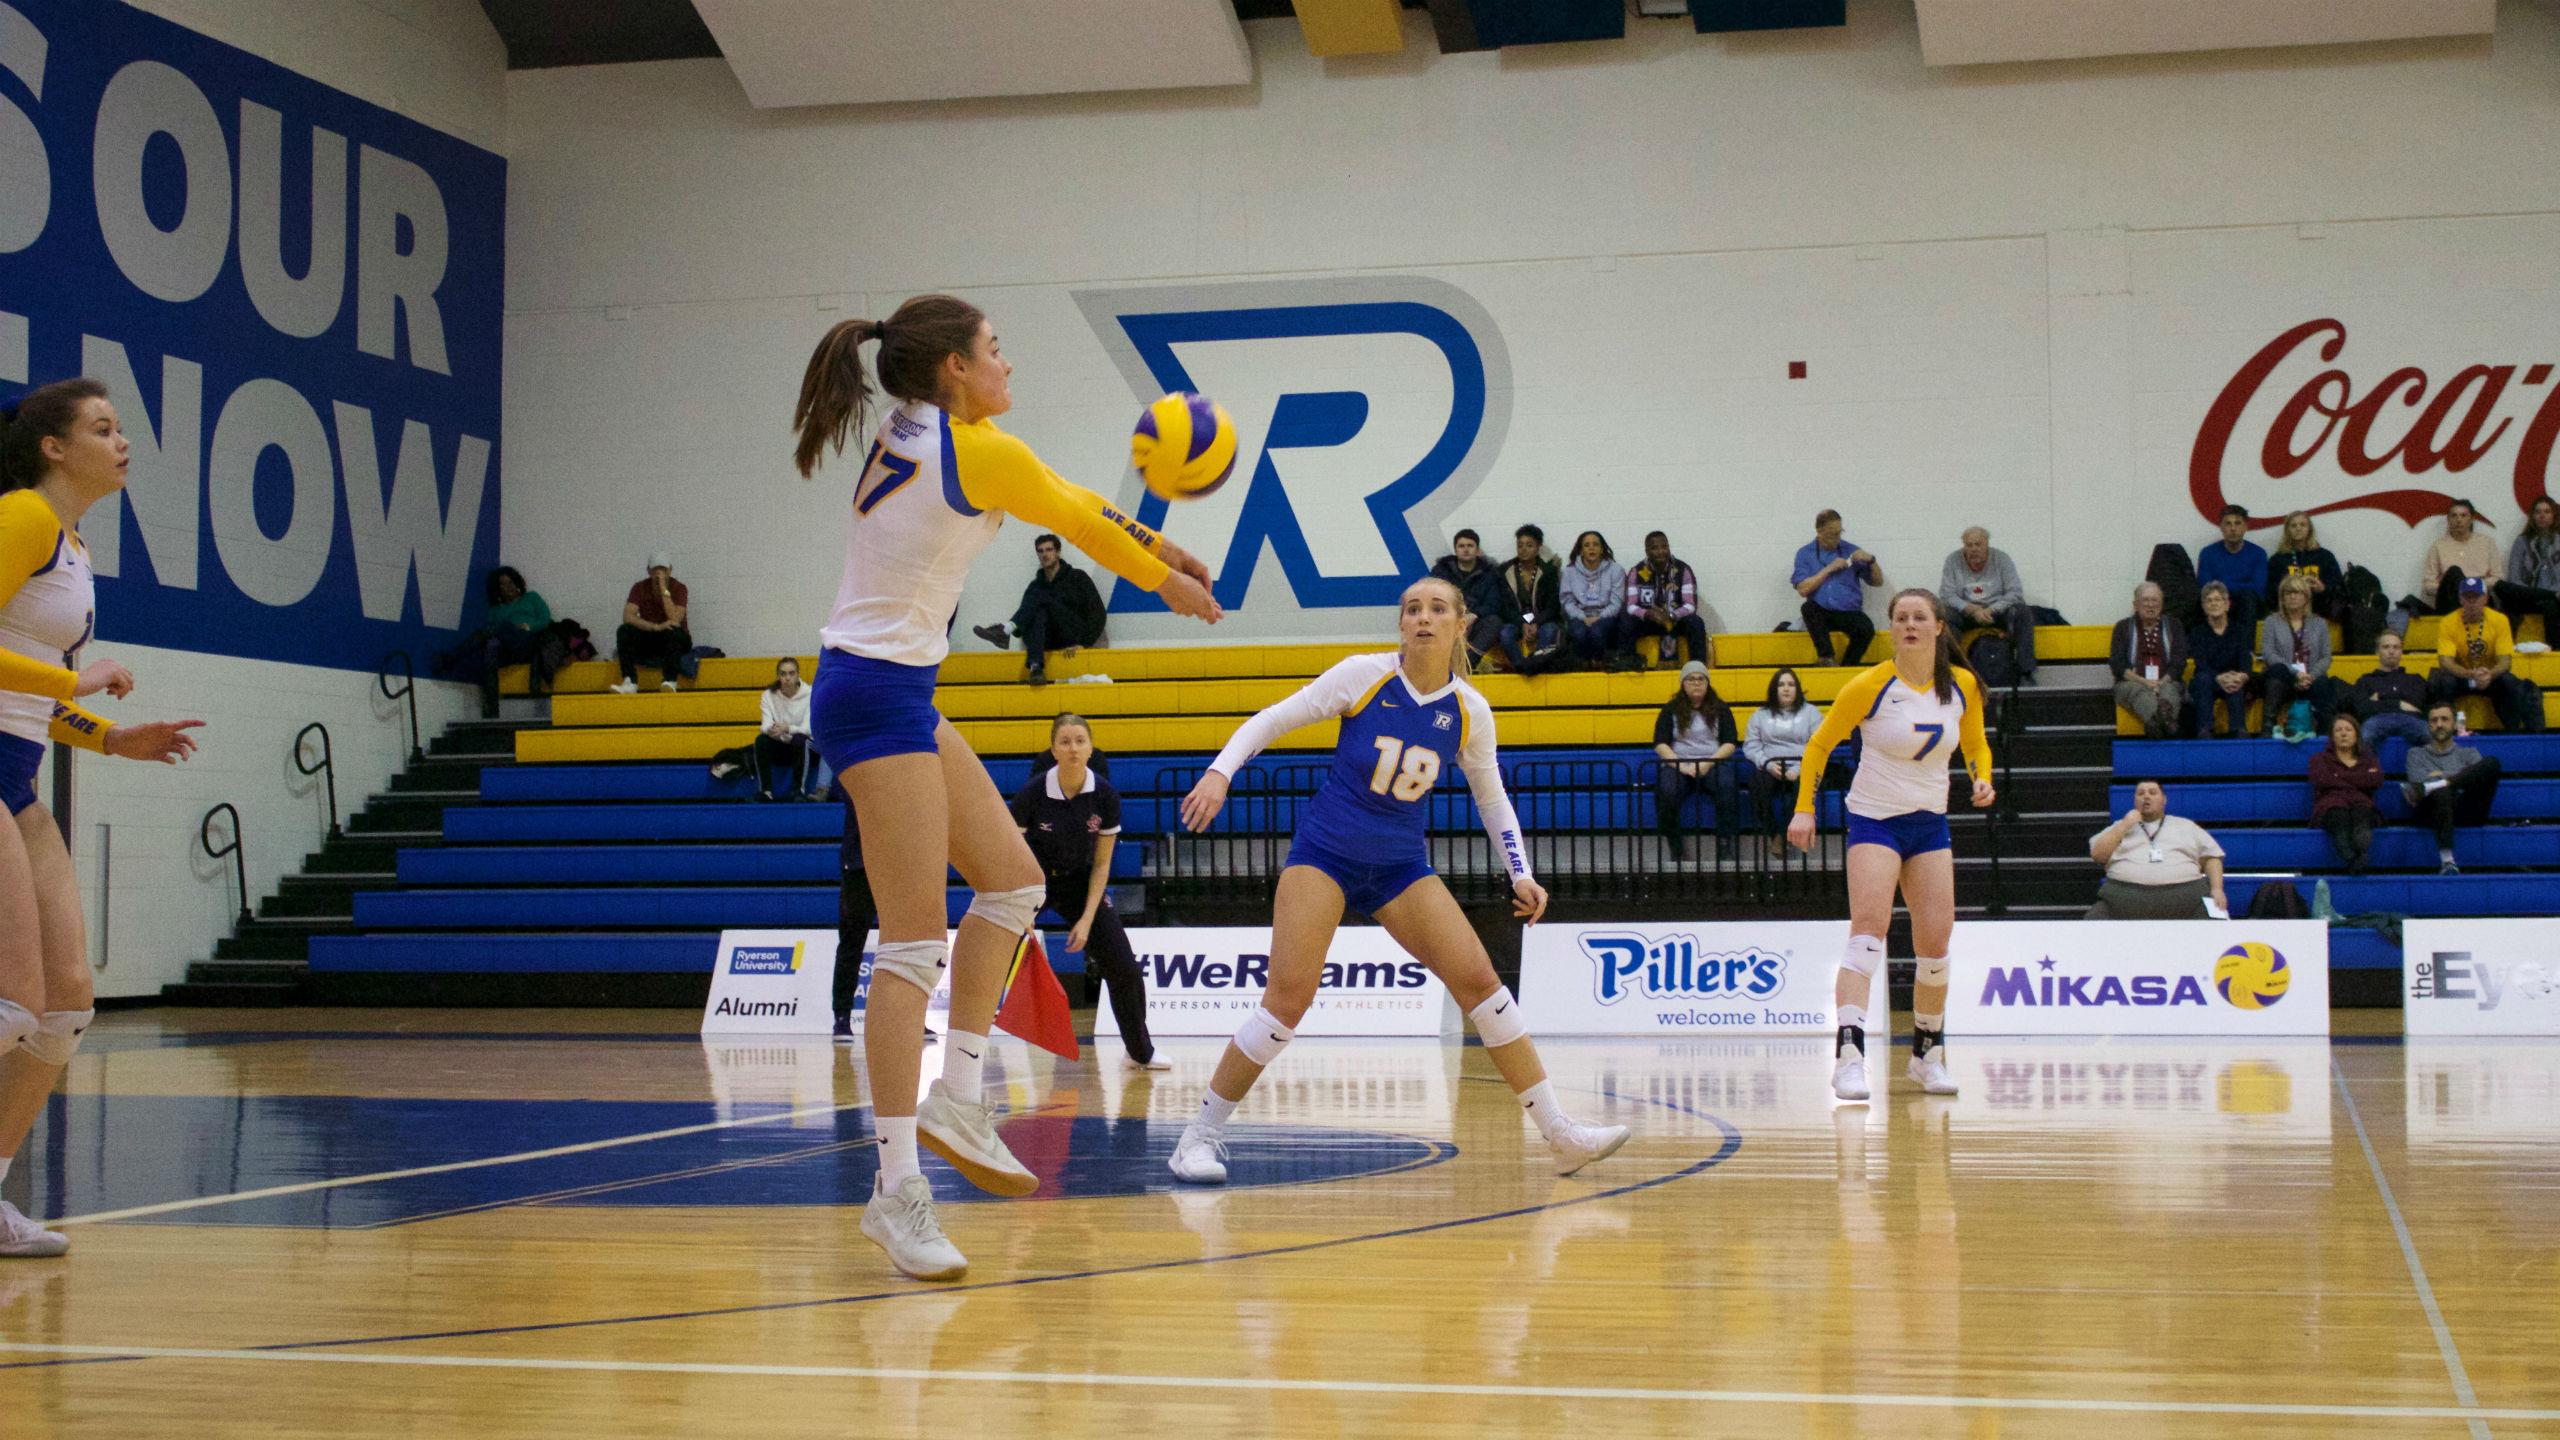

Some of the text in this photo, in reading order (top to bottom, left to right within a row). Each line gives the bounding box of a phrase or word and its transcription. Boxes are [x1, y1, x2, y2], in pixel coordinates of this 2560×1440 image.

[93, 60, 452, 376] OUR
[82, 334, 491, 630] NOW
[853, 438, 922, 519] 17
[1102, 506, 1155, 547] WE ARE
[62, 713, 98, 736] ARE
[1913, 723, 1944, 761] 7
[1369, 735, 1441, 803] 18
[1501, 829, 1524, 874] WE ARE
[735, 961, 787, 972] University
[737, 950, 779, 961] Ryerson
[1585, 938, 1779, 1000] Piller's
[2410, 962, 2433, 999] the
[715, 997, 798, 1017] Alumni
[1149, 1001, 1221, 1010] RYERSON
[1335, 1001, 1424, 1010] ATHLETICS
[1657, 1009, 1826, 1025] welcome home
